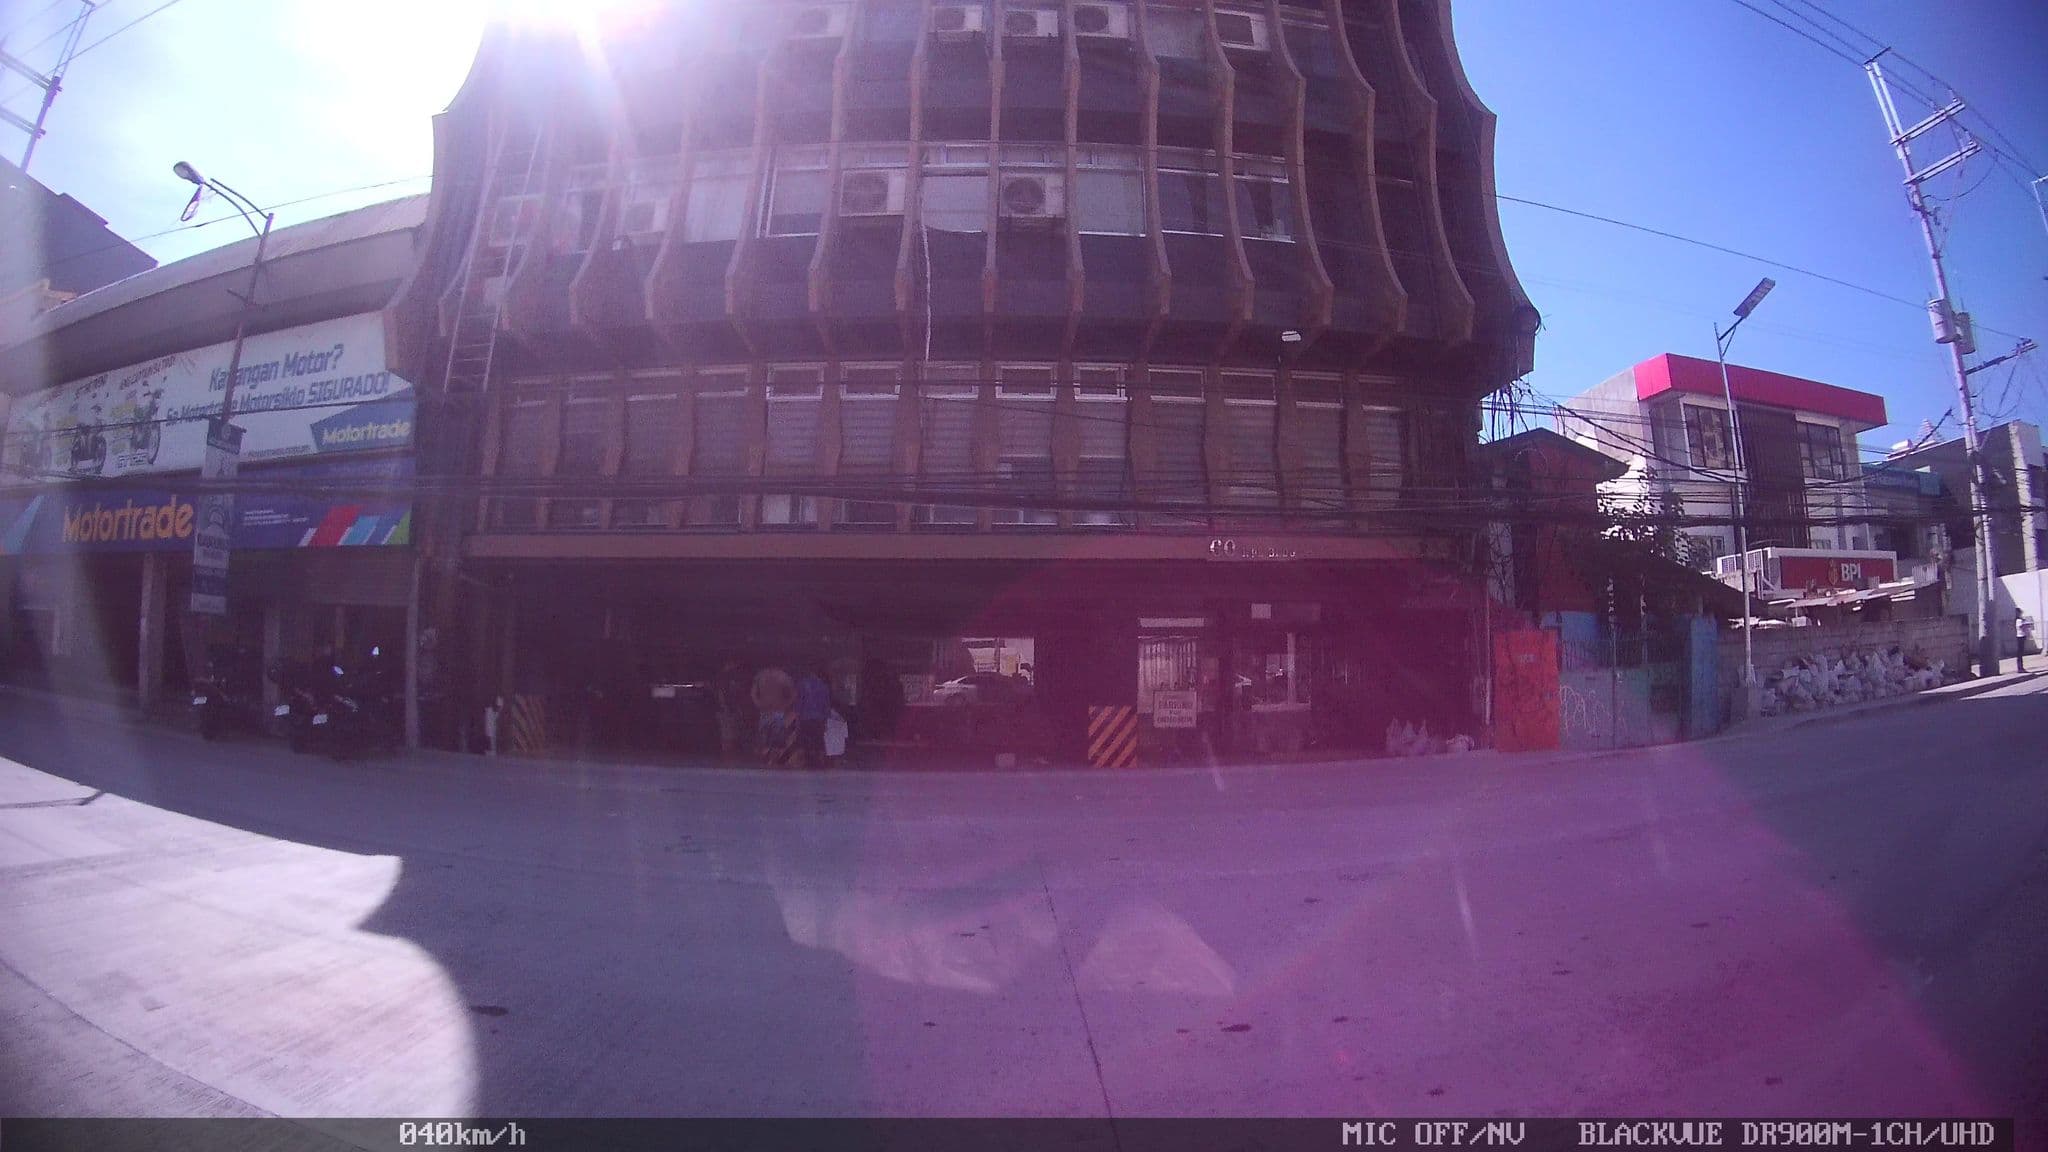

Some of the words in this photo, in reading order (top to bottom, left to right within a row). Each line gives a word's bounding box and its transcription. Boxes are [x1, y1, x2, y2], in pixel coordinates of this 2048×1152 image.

[282, 343, 344, 378] Motor?
[240, 386, 305, 410] Motorsiklo
[307, 371, 392, 405] SIGURADO!
[322, 419, 410, 445] Motortrade
[63, 494, 194, 543] Motortrade
[1840, 563, 1861, 582] BPI
